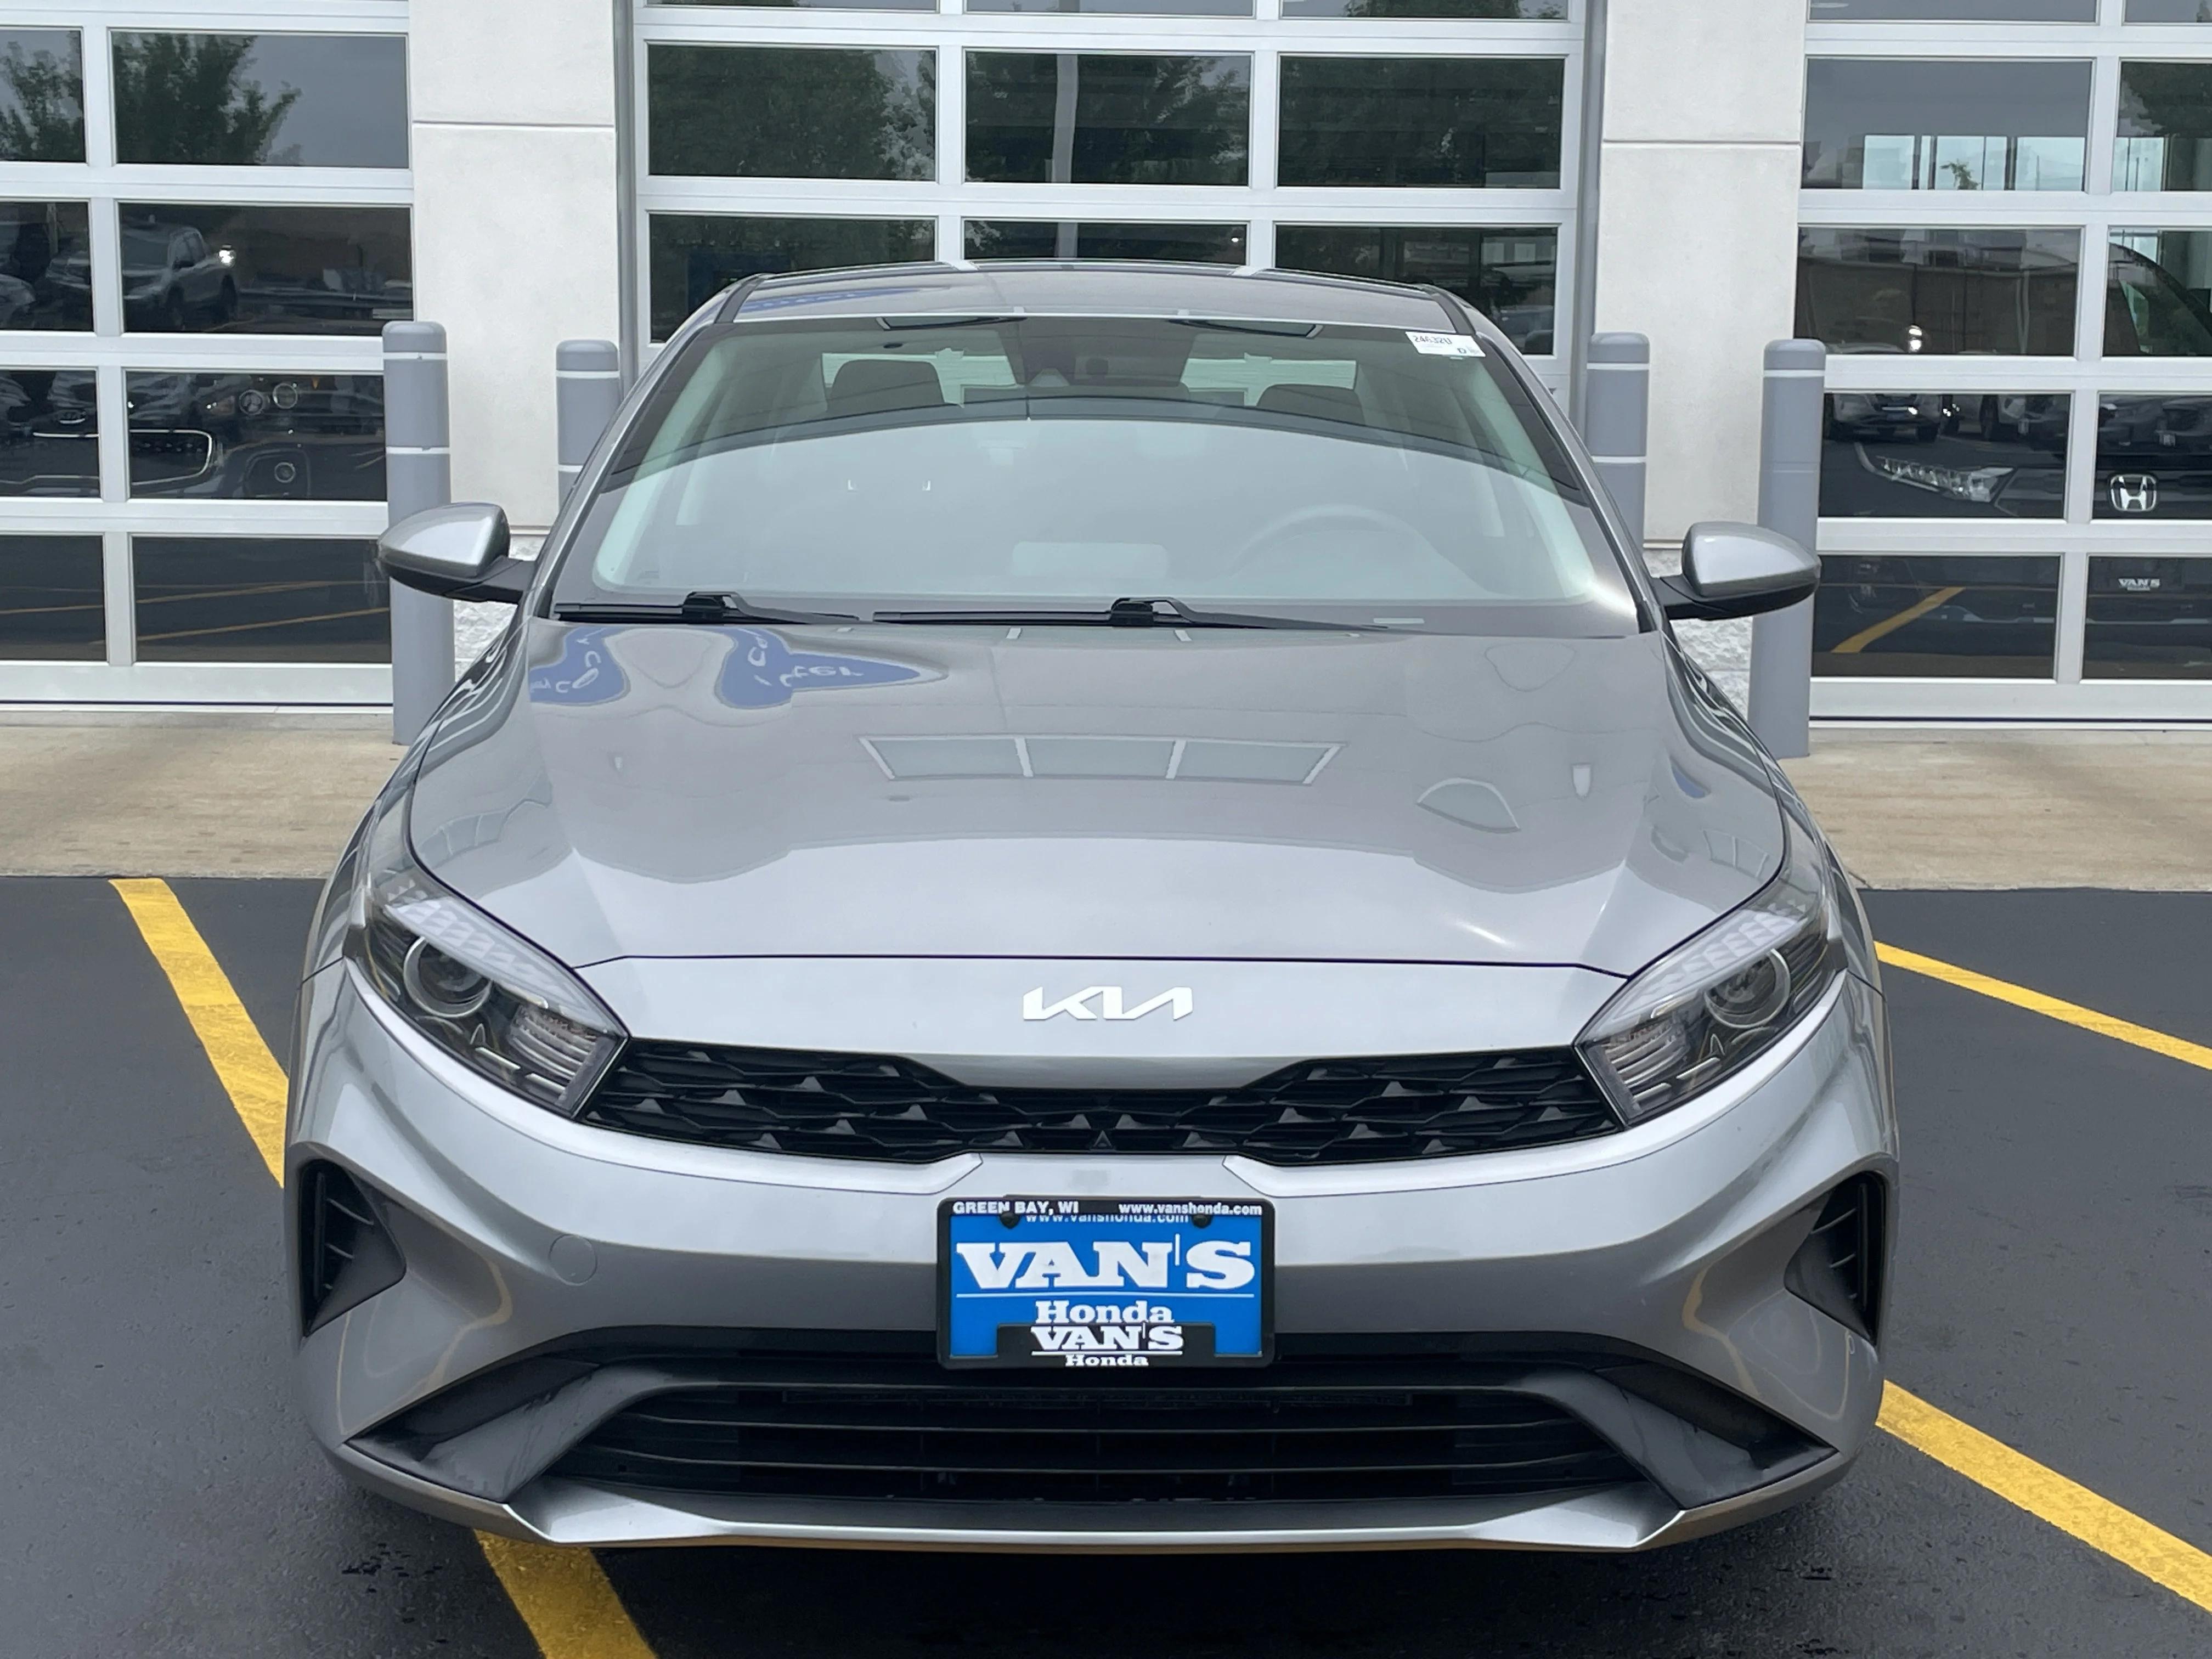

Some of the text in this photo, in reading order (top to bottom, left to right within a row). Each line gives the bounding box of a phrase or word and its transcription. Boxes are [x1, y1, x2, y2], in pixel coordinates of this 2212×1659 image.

[952, 1201, 1079, 1215] GREEN BAY, WI
[1119, 1202, 1262, 1215] www.vanshonda.com
[956, 1233, 1255, 1289] VAN'S
[1035, 1300, 1175, 1324] Honda
[1030, 1322, 1184, 1351] VAN'S
[1065, 1355, 1149, 1367] Honda
